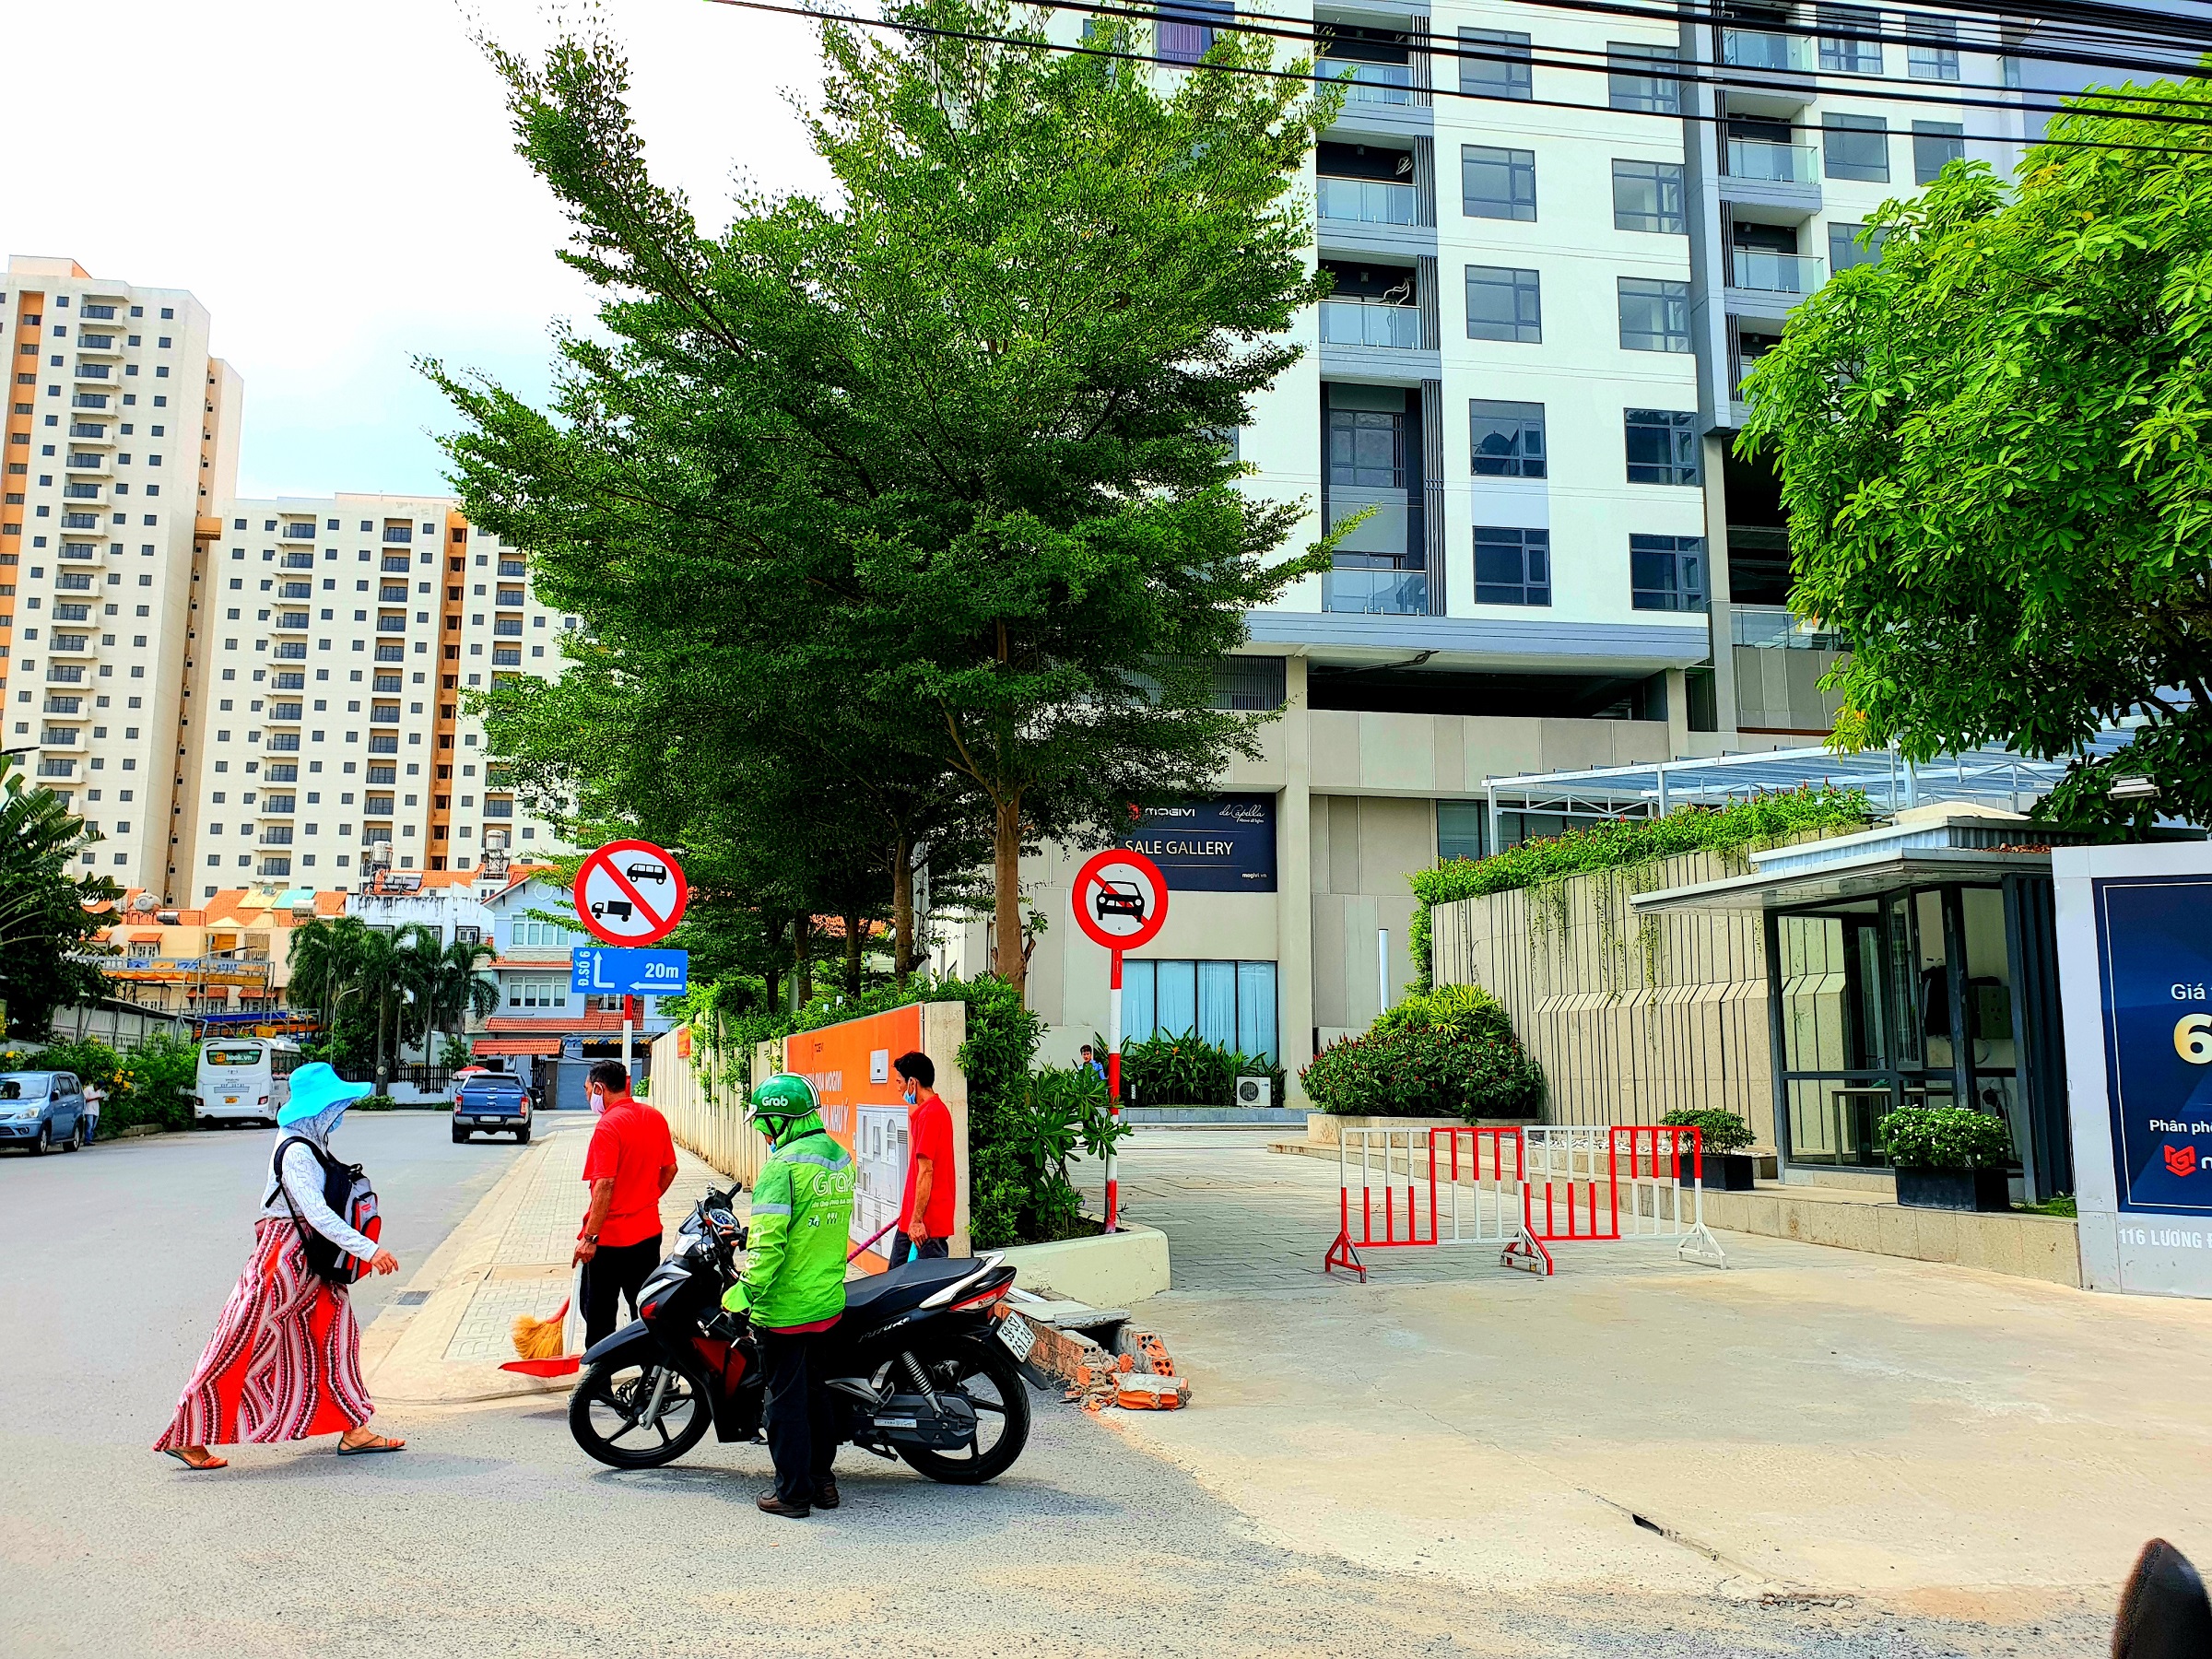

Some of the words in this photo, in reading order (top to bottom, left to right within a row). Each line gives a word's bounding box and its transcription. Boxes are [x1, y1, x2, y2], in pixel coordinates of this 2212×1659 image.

[1124, 840, 1162, 854] SALE
[1166, 841, 1233, 855] GALLERY
[645, 962, 679, 979] 20m
[2171, 982, 2206, 1000] Giá
[2173, 1013, 2212, 1065] 6
[761, 1095, 789, 1107] Grab
[2149, 1119, 2187, 1133] Phân
[2120, 1228, 2147, 1246] 116
[2150, 1229, 2203, 1250] LƯƠNG
[1012, 1327, 1033, 1359] 261.39
